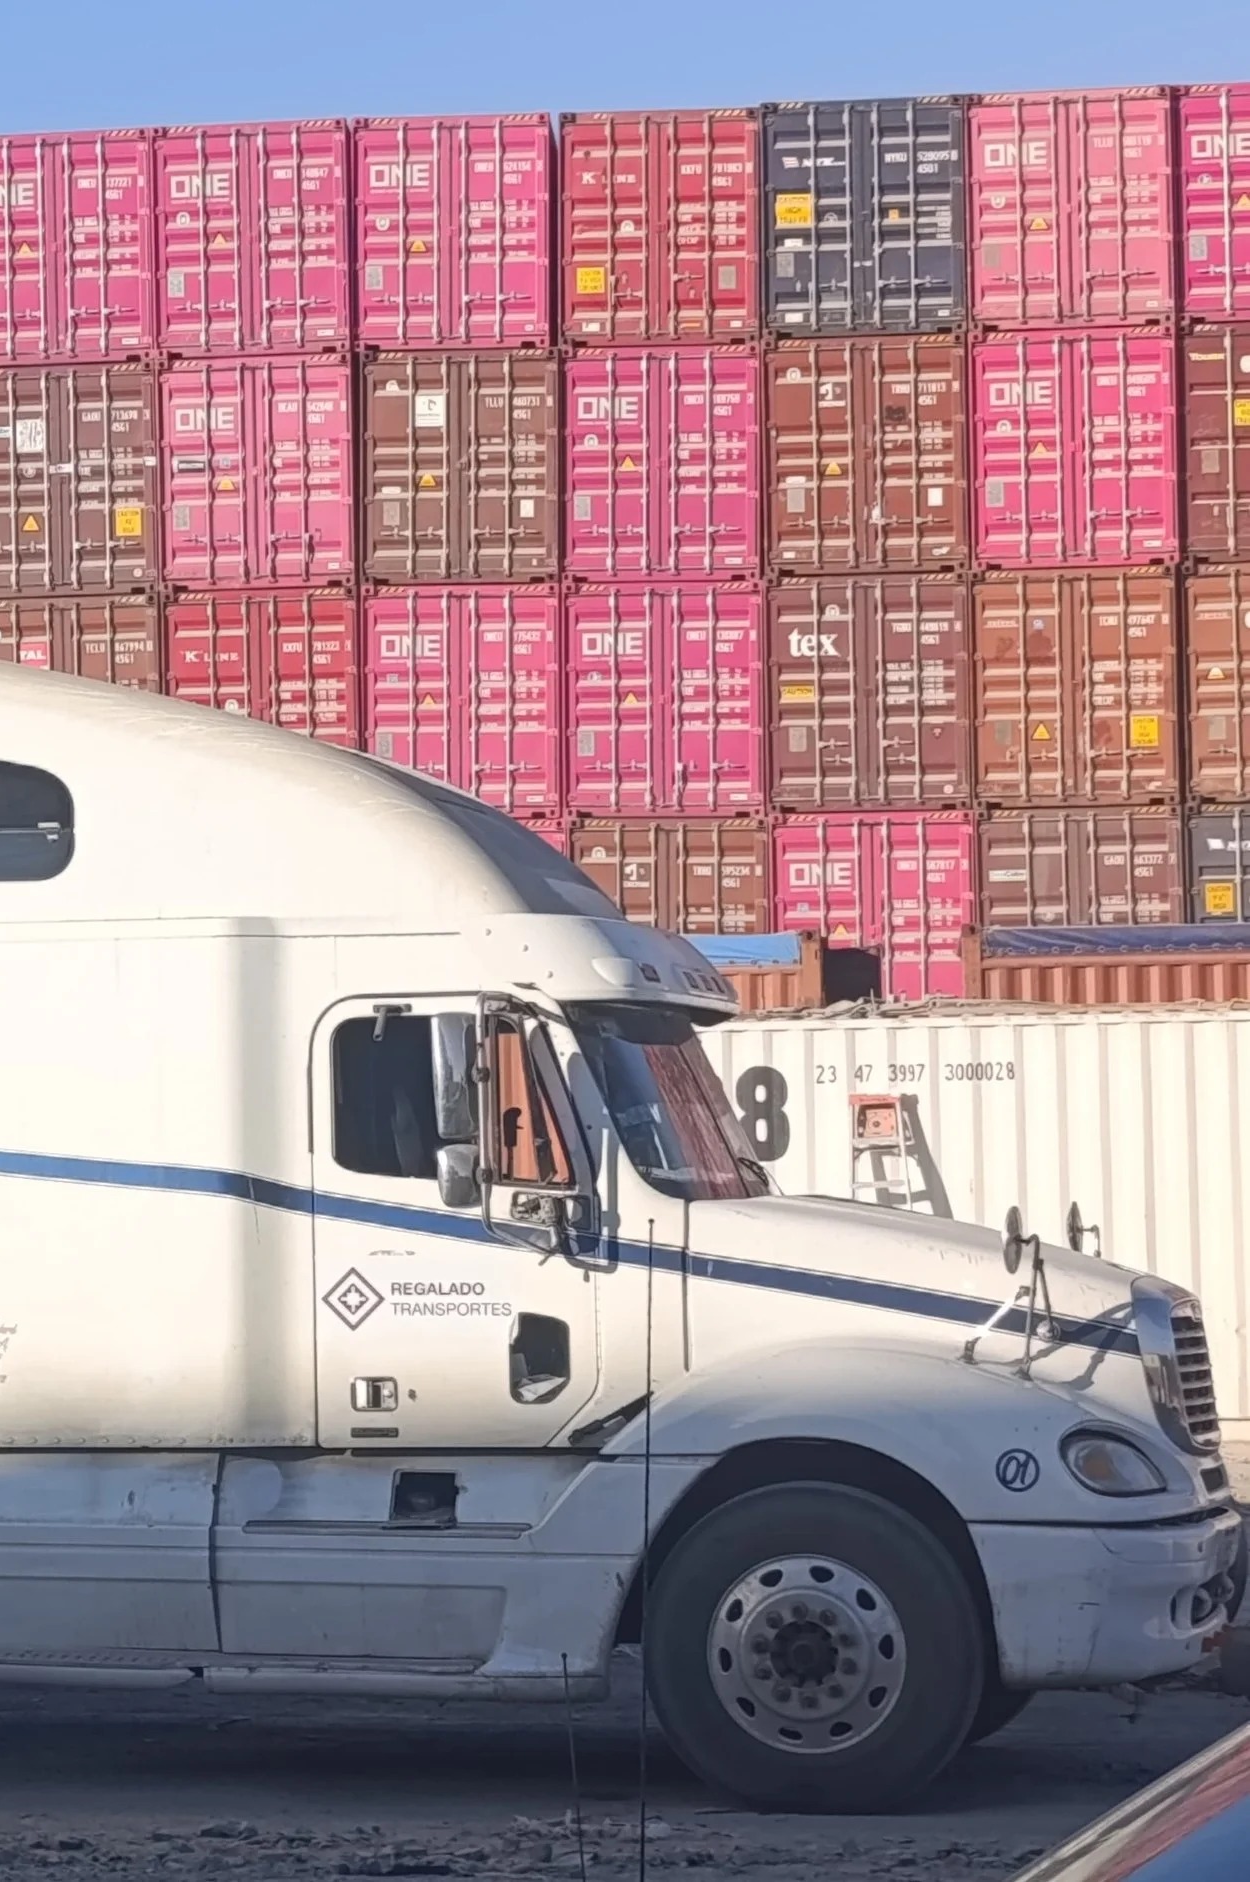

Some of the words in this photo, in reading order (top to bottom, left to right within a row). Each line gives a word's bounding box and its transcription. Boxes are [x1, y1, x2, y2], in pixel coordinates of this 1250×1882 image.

[984, 142, 1048, 167] ONE
[170, 173, 230, 197] ONE
[370, 164, 430, 187] ONE
[989, 381, 1052, 405] ONE
[175, 407, 234, 432] ONE
[578, 397, 638, 419] ONE
[380, 635, 440, 657] ONE
[582, 632, 643, 655] ONE
[789, 628, 840, 656] tex
[20, 650, 46, 659] TAL
[790, 863, 851, 885] ONE
[816, 1064, 837, 1084] 23
[854, 1064, 873, 1083] 47
[888, 1063, 925, 1082] 3997
[944, 1060, 1015, 1081] 3000028
[736, 1066, 790, 1162] 8
[390, 1282, 485, 1296] REGALADO
[390, 1302, 512, 1316] TRANSPORTES
